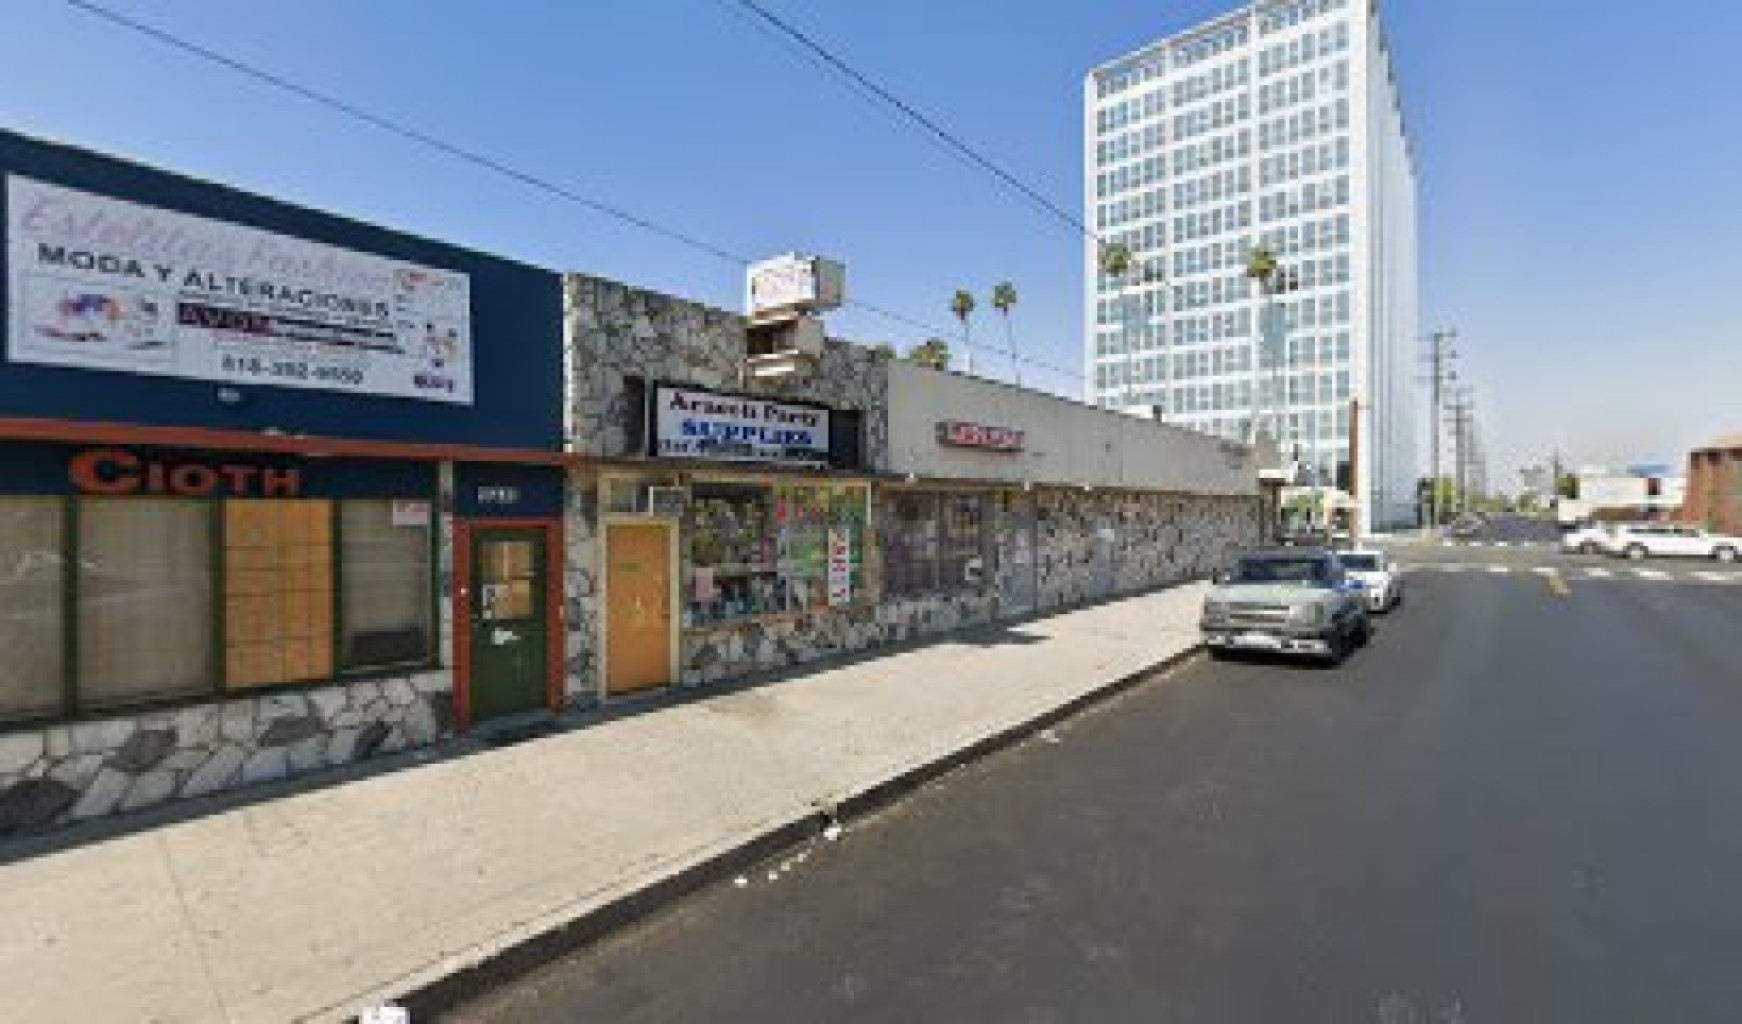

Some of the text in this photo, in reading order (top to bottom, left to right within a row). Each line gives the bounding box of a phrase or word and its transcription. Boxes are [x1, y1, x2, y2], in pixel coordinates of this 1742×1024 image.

[38, 242, 146, 279] MODA
[152, 264, 173, 282] Y
[183, 267, 390, 318] ALTERACIONES
